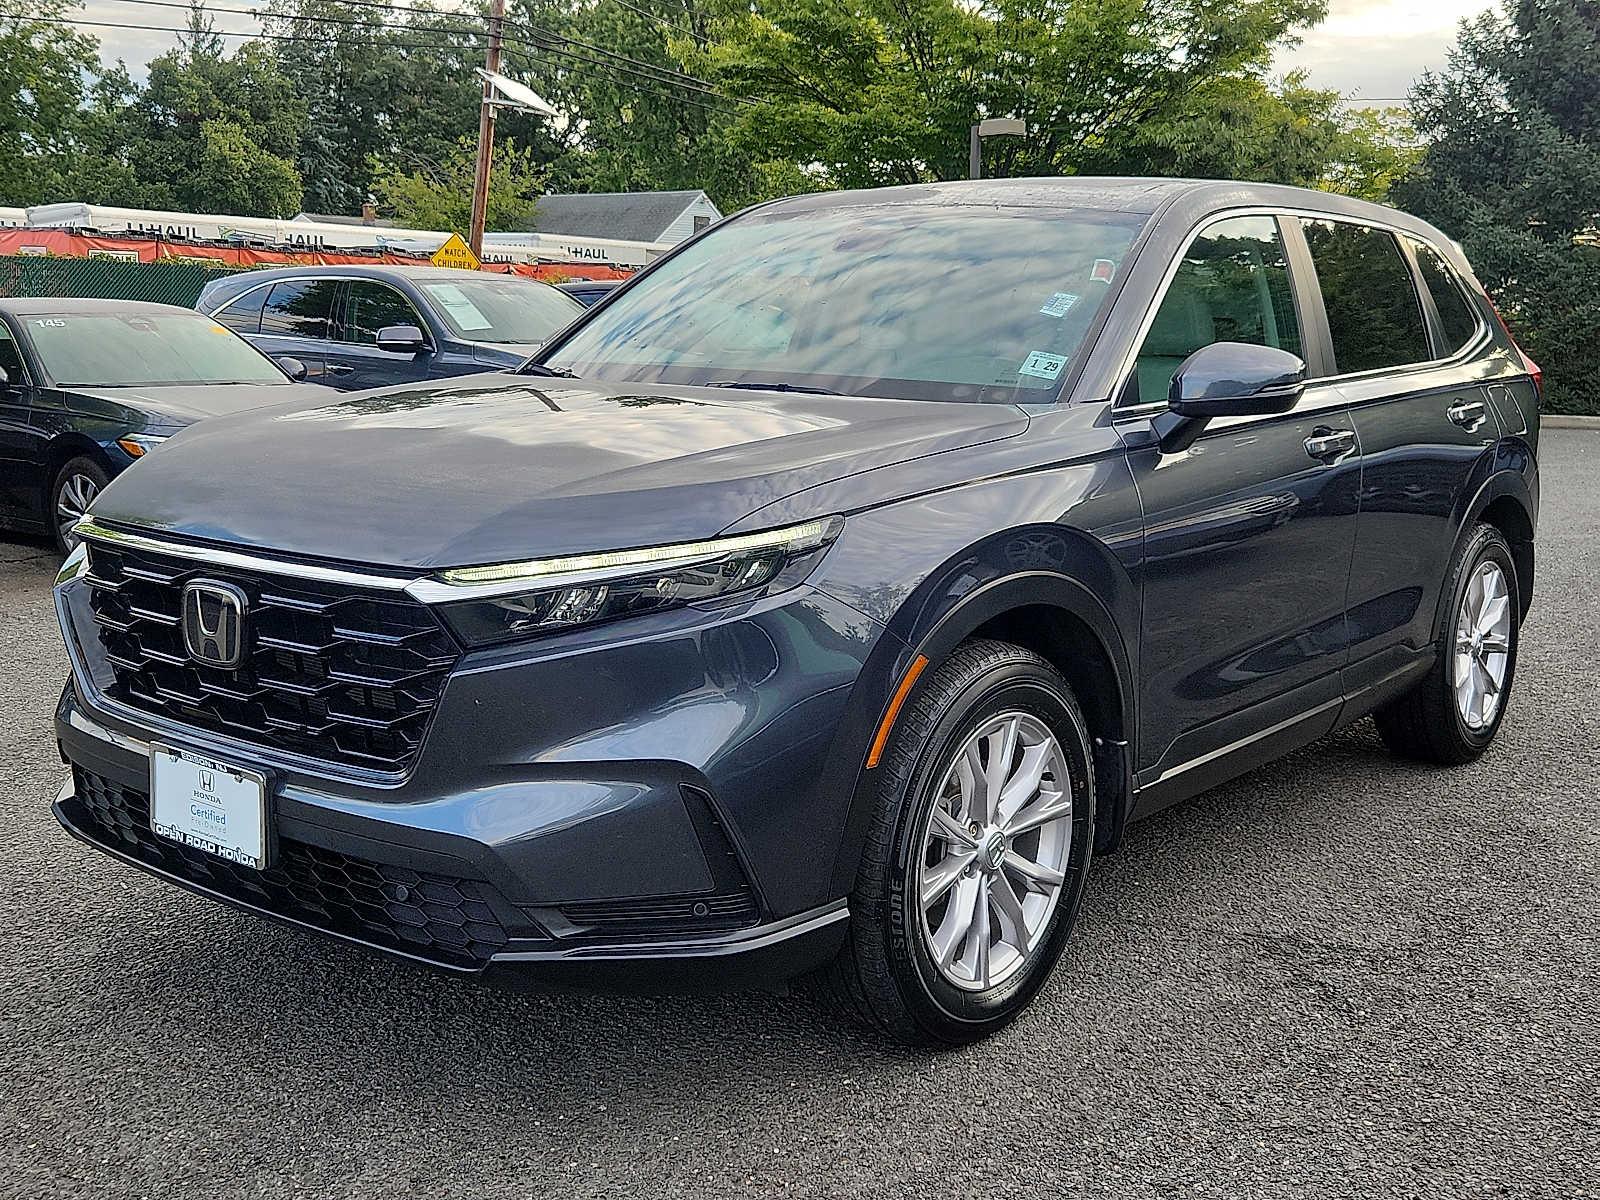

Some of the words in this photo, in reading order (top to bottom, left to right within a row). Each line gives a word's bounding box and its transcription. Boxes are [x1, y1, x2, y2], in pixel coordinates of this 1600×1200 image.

[444, 248, 467, 258] WATCH
[437, 259, 473, 270] CHILDREN
[35, 318, 66, 329] 145
[1030, 358, 1040, 369] 1
[1042, 361, 1060, 372] 29
[214, 763, 228, 773] NJ
[193, 790, 222, 805] HONDA
[190, 804, 226, 825] Certified
[155, 824, 184, 843] OPEN
[185, 834, 216, 853] ROAD
[217, 845, 257, 868] HONDA
